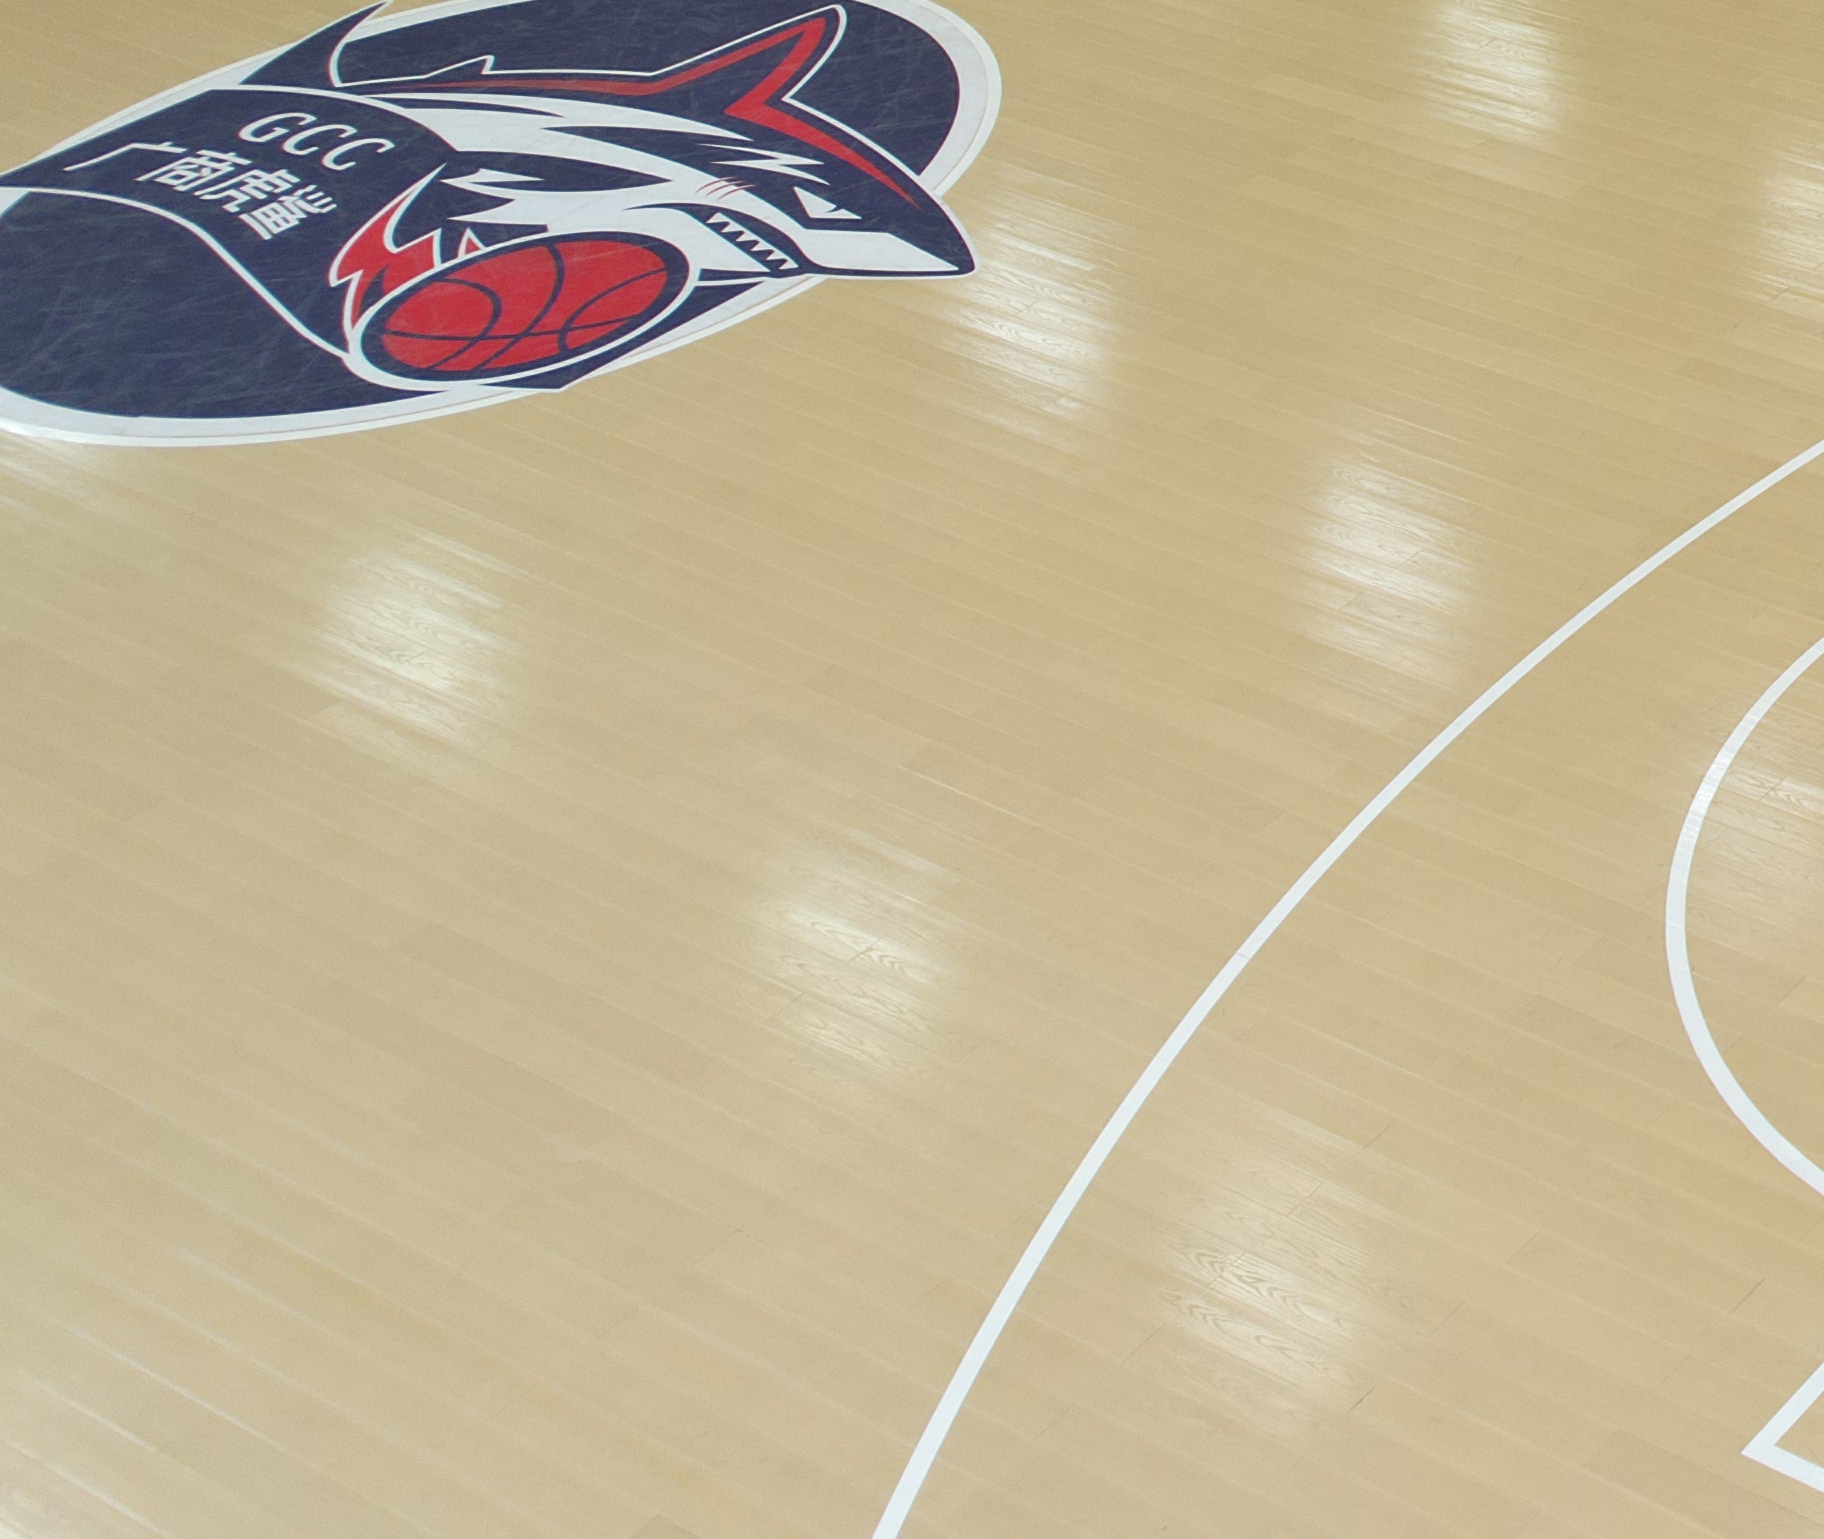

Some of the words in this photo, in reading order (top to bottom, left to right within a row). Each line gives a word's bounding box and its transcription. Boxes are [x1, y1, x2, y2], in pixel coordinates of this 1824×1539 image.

[238, 112, 395, 171] GCC
[63, 141, 338, 241] 广商虎鲨
